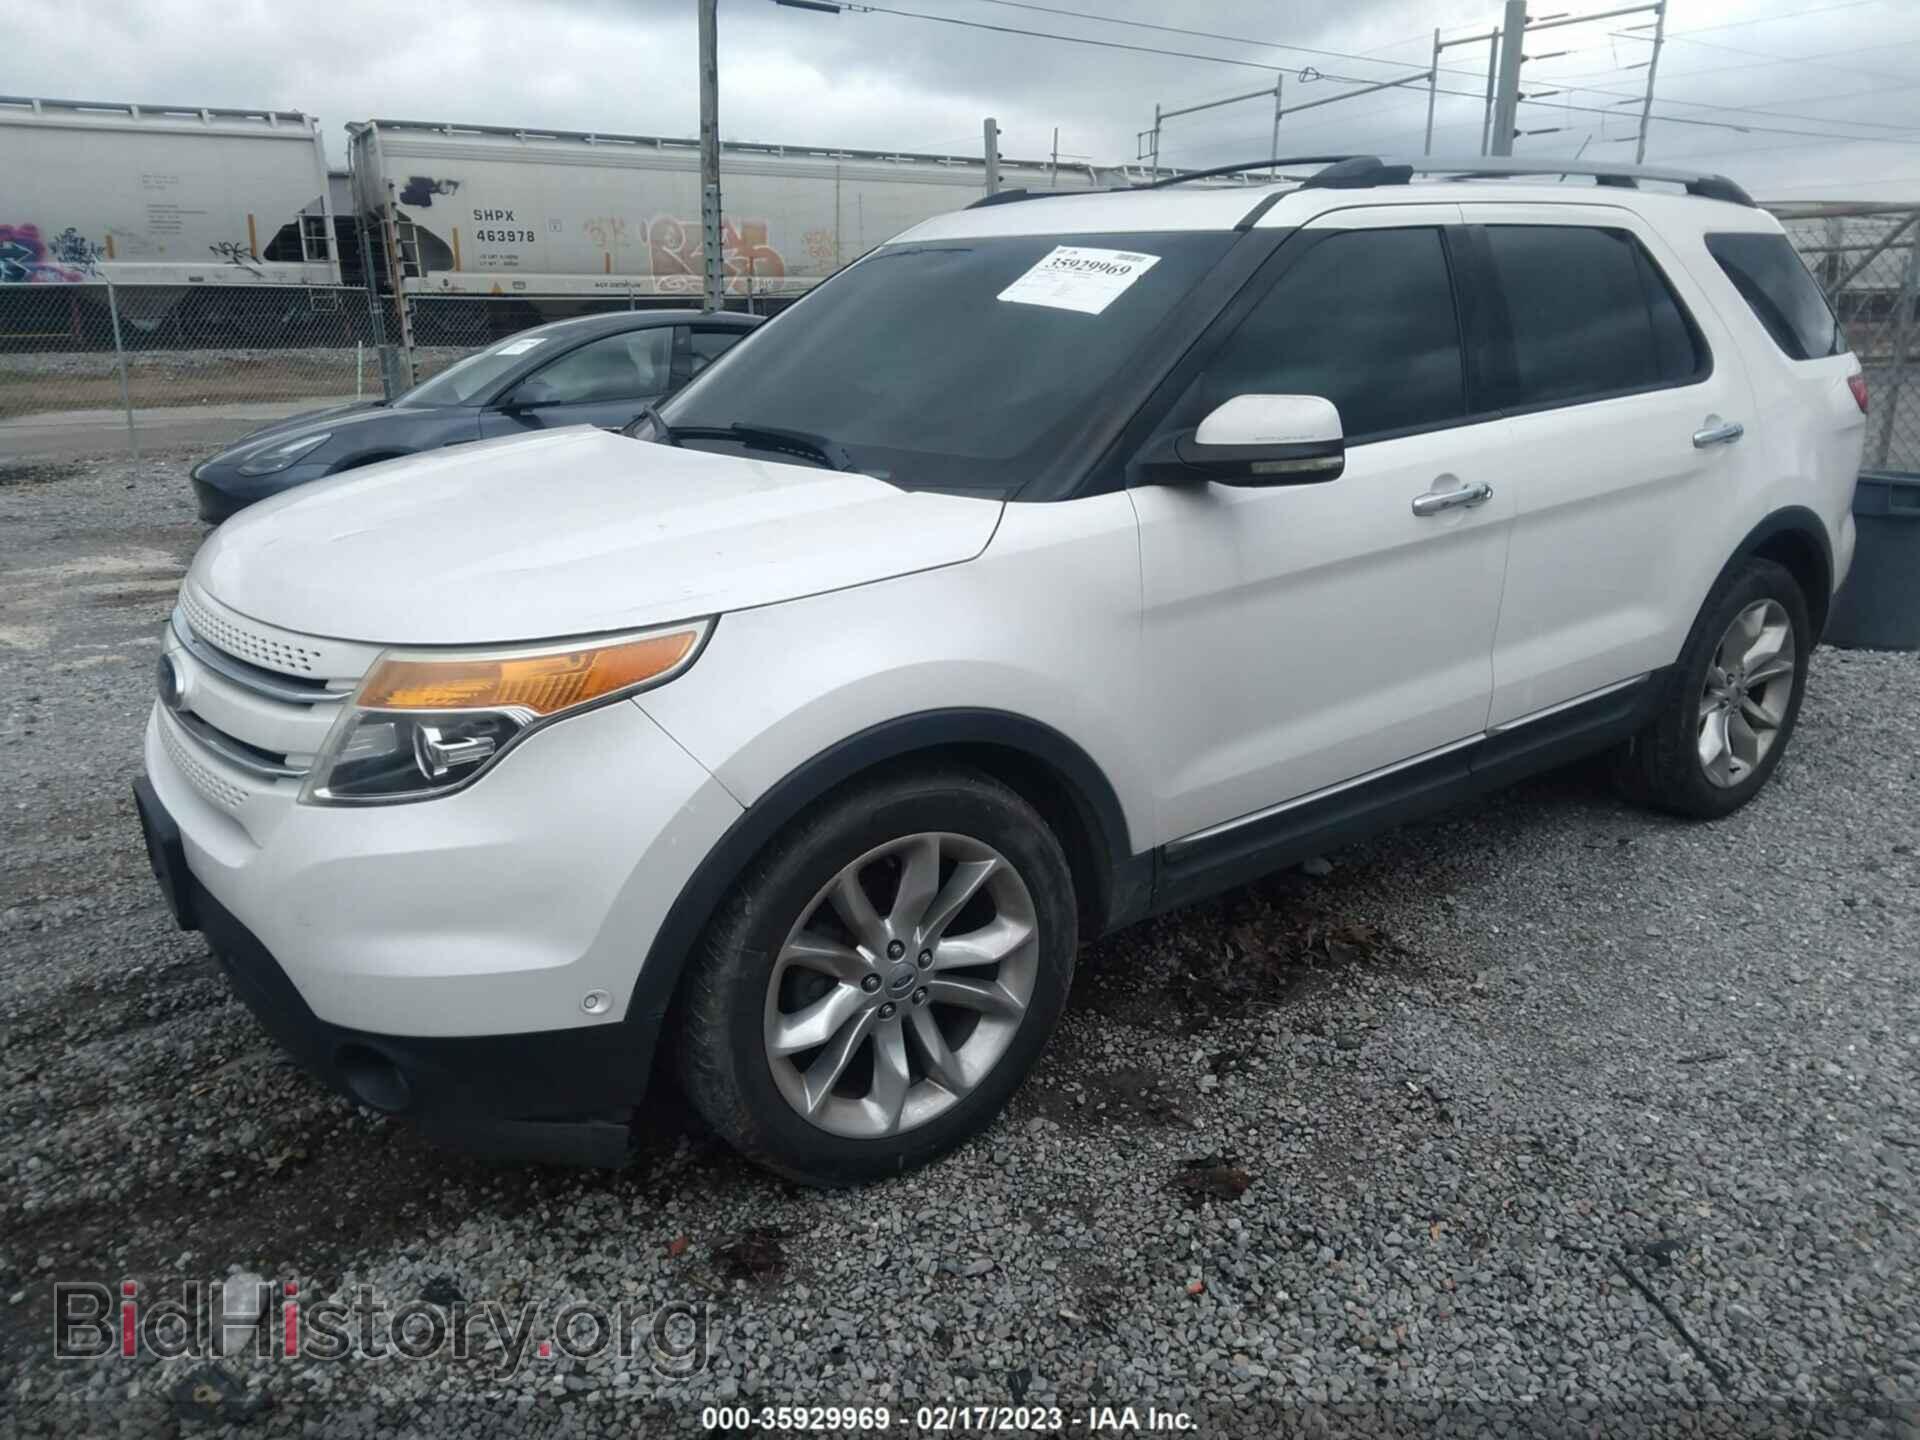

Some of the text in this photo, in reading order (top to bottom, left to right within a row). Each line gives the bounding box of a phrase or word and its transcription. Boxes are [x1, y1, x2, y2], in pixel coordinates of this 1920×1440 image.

[473, 209, 514, 221] SHPX
[477, 230, 535, 242] 463978
[1044, 257, 1132, 276] 35929969
